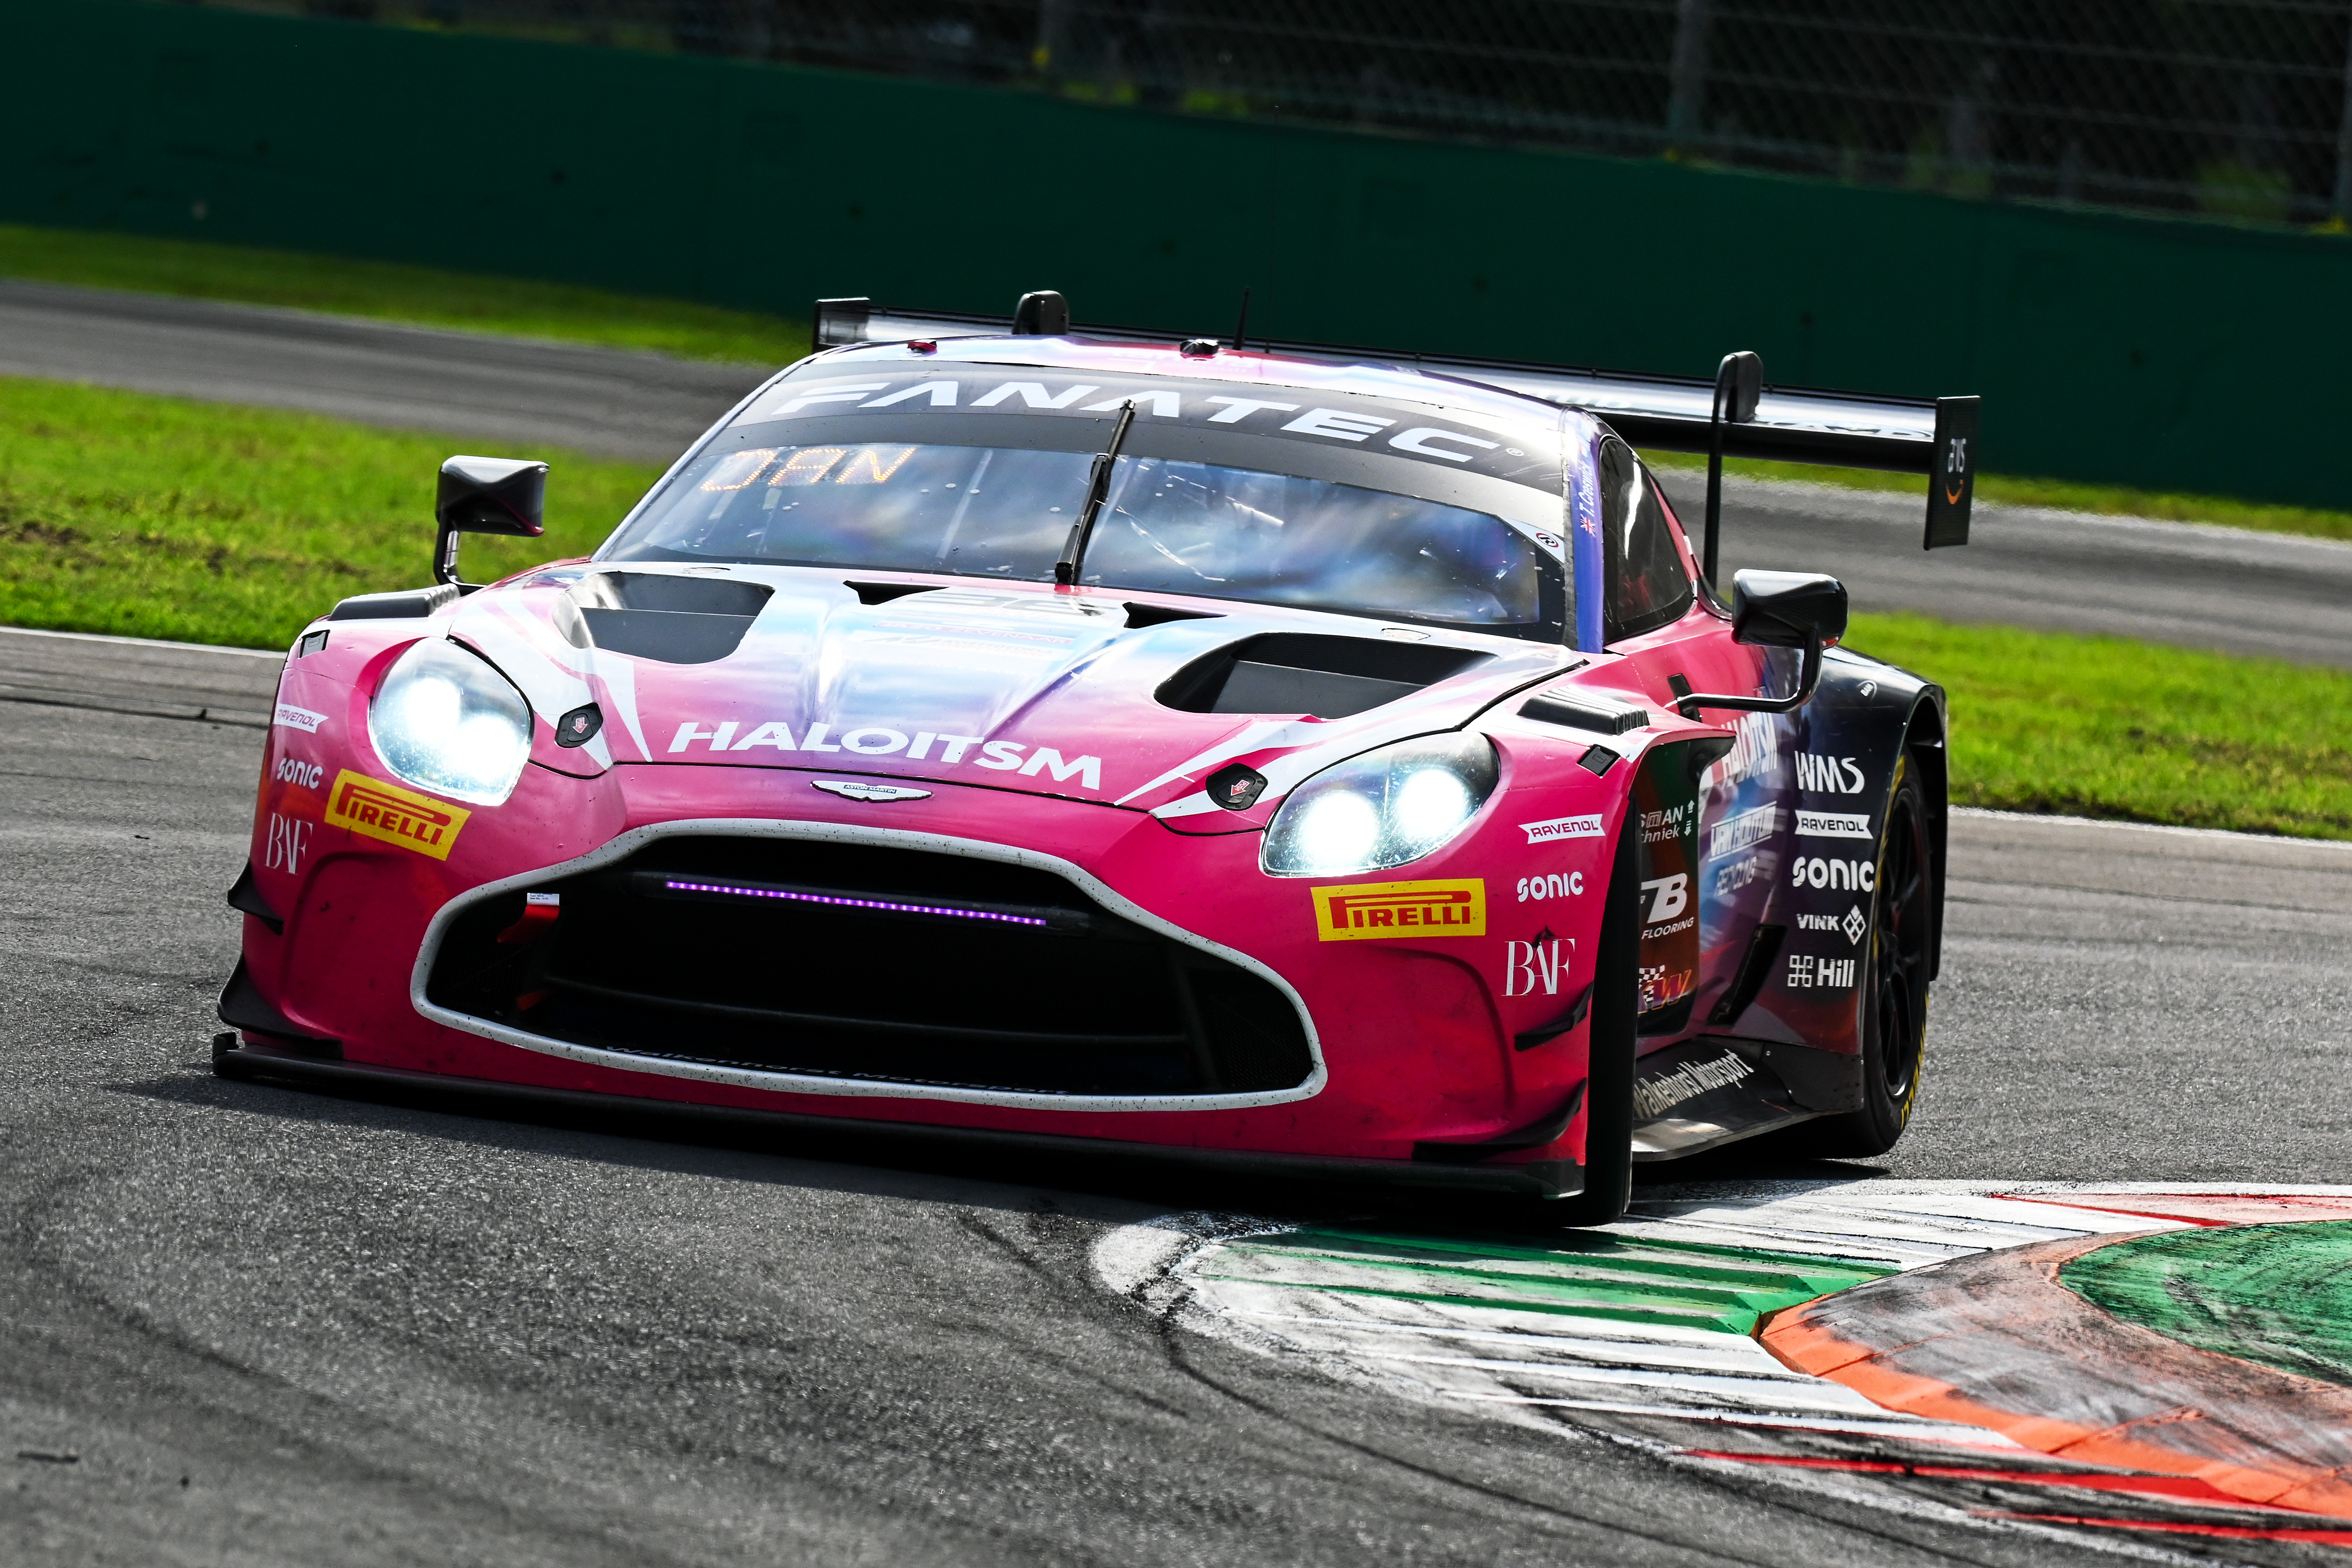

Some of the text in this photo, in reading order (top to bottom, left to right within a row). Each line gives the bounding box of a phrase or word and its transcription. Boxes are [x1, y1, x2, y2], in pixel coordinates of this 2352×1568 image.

[772, 381, 1501, 462] FANATEC
[701, 447, 916, 491] JAN
[1578, 460, 1594, 506] Creswick
[276, 709, 317, 727] RAVENOL
[667, 721, 1102, 791] HALOITSM
[1794, 751, 1864, 793] WMS
[336, 782, 452, 845] PIRELLI
[1529, 819, 1599, 837] RAVENOL
[1801, 817, 1865, 832] RAVENOL
[1329, 891, 1471, 929] PIRELLI
[1642, 917, 1694, 939] FLOORING
[1796, 914, 1839, 931] VINK
[1816, 959, 1855, 987] Hill
[606, 1046, 1069, 1094] Walkenhorst Motorsport
[1679, 1048, 1755, 1090] Motorsport
